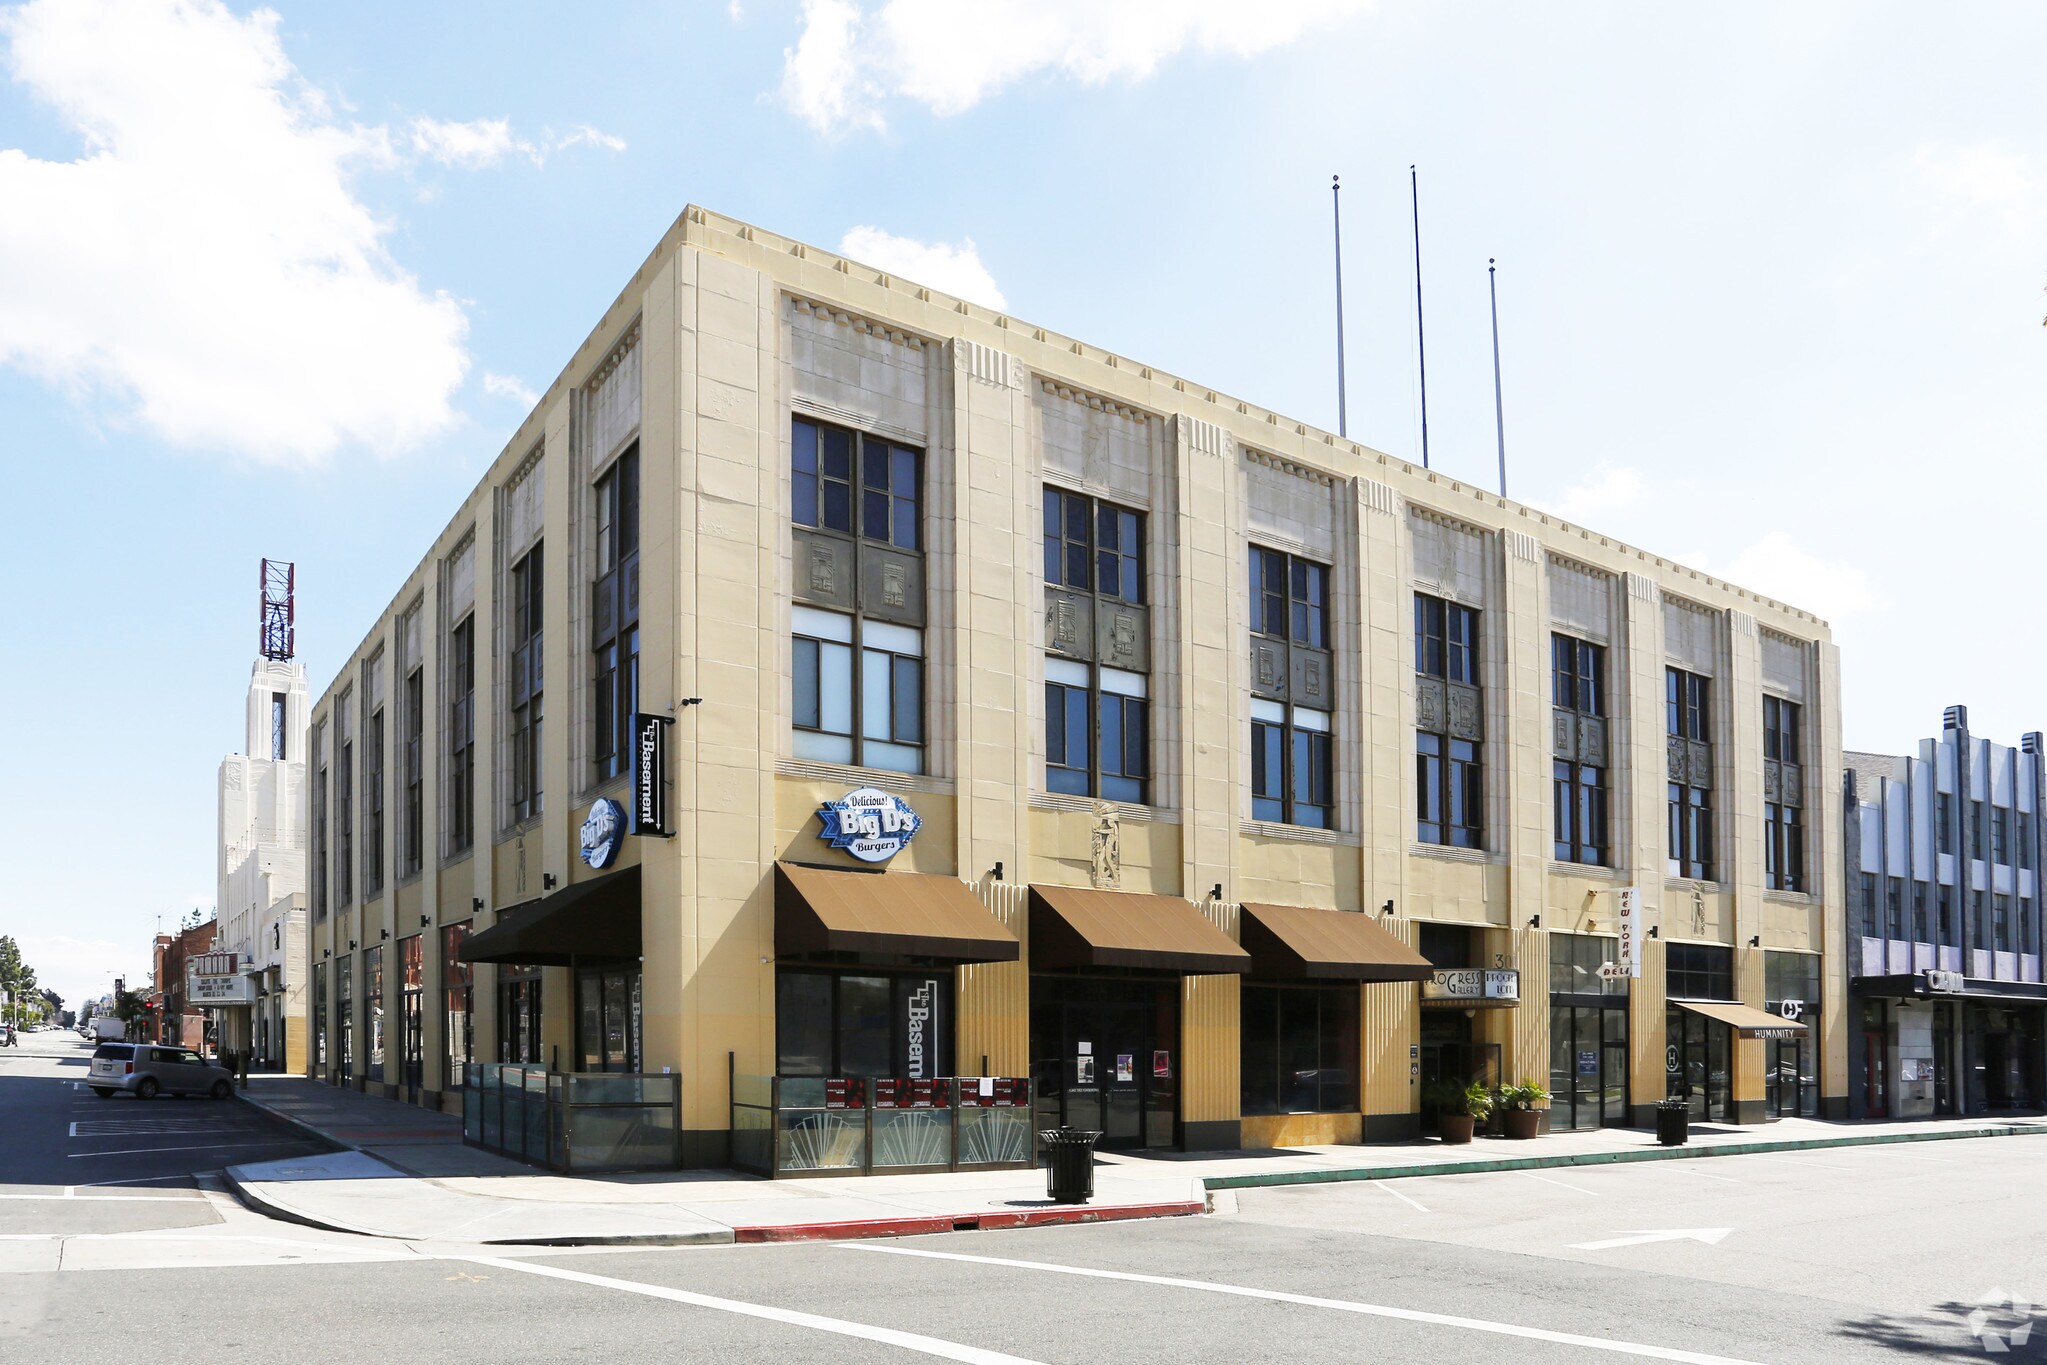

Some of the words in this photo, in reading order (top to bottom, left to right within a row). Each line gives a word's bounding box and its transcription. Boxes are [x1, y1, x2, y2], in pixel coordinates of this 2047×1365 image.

[642, 741, 655, 824] Basement
[850, 796, 888, 807] Delicious!
[840, 809, 880, 840] Big
[882, 808, 915, 832] D's
[855, 841, 895, 852] Burgers
[1603, 967, 1630, 976] DELI
[1425, 972, 1480, 994] OGRESS
[1754, 1029, 1794, 1039] HUMANITY
[908, 1007, 929, 1078] Basem
